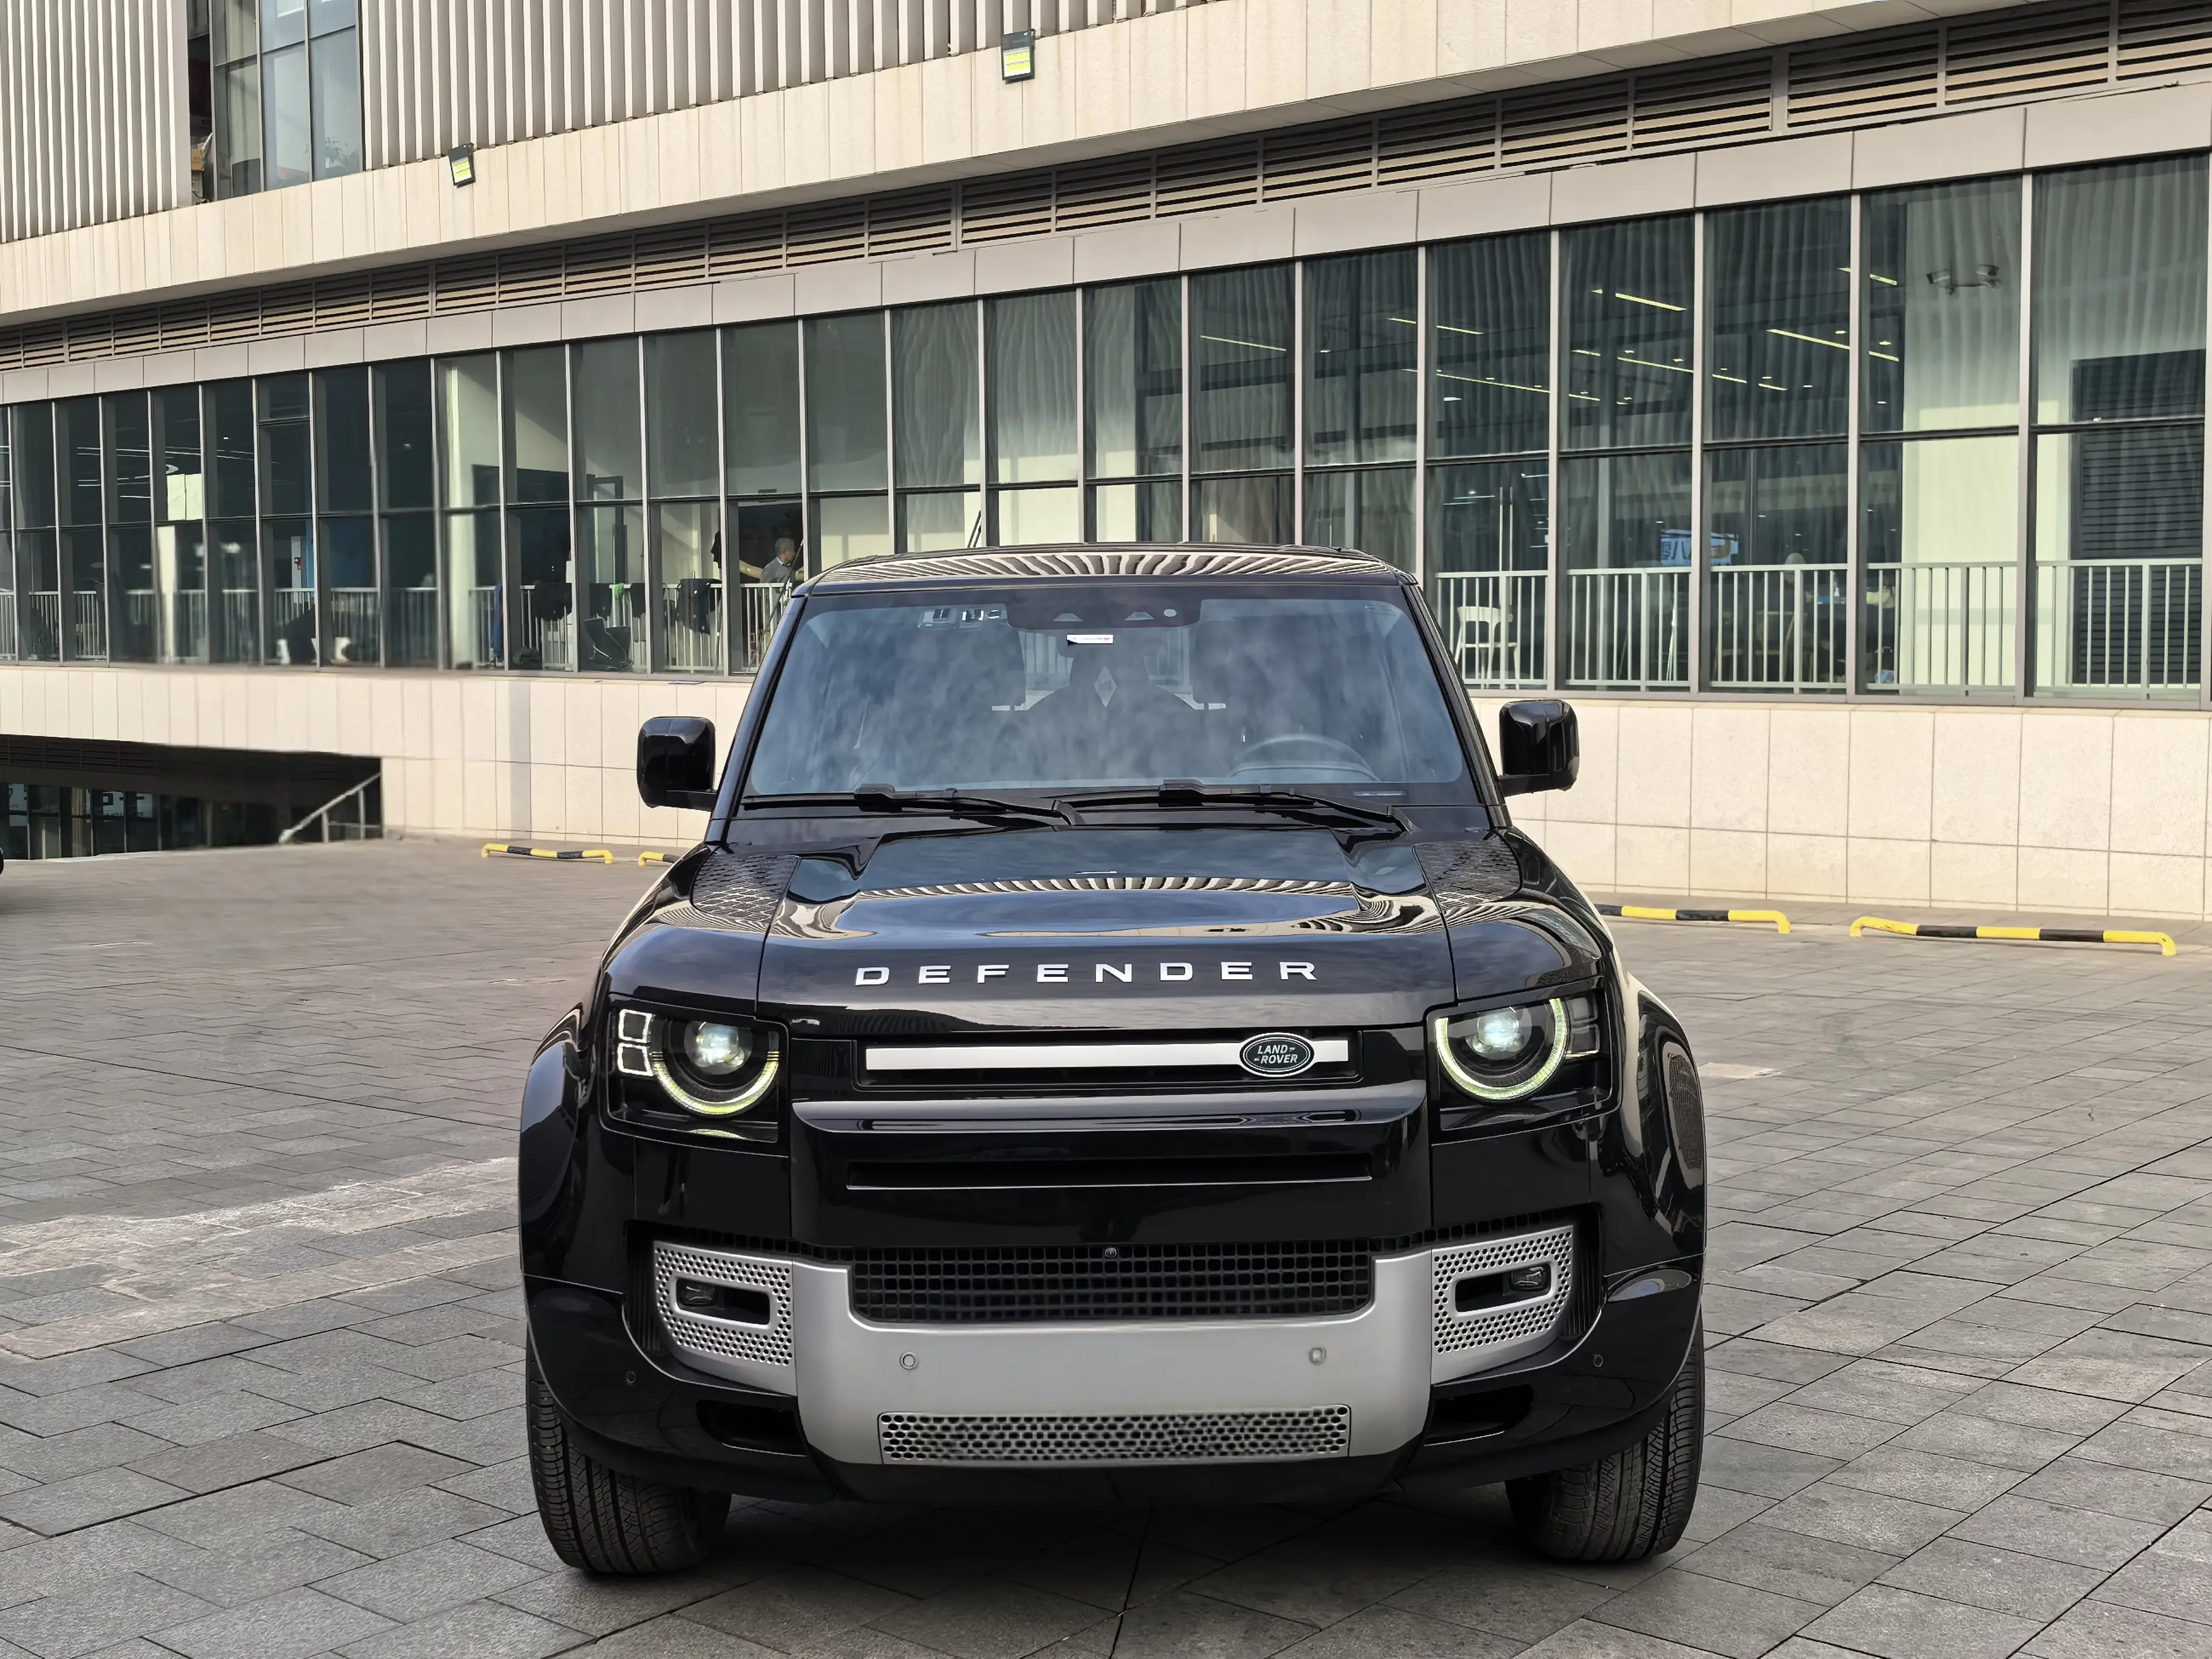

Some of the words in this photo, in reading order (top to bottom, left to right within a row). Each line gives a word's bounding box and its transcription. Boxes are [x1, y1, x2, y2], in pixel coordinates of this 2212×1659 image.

[854, 961, 1317, 986] DEFENDER
[1257, 1044, 1287, 1054] LAND
[1260, 1054, 1298, 1064] ROVER
